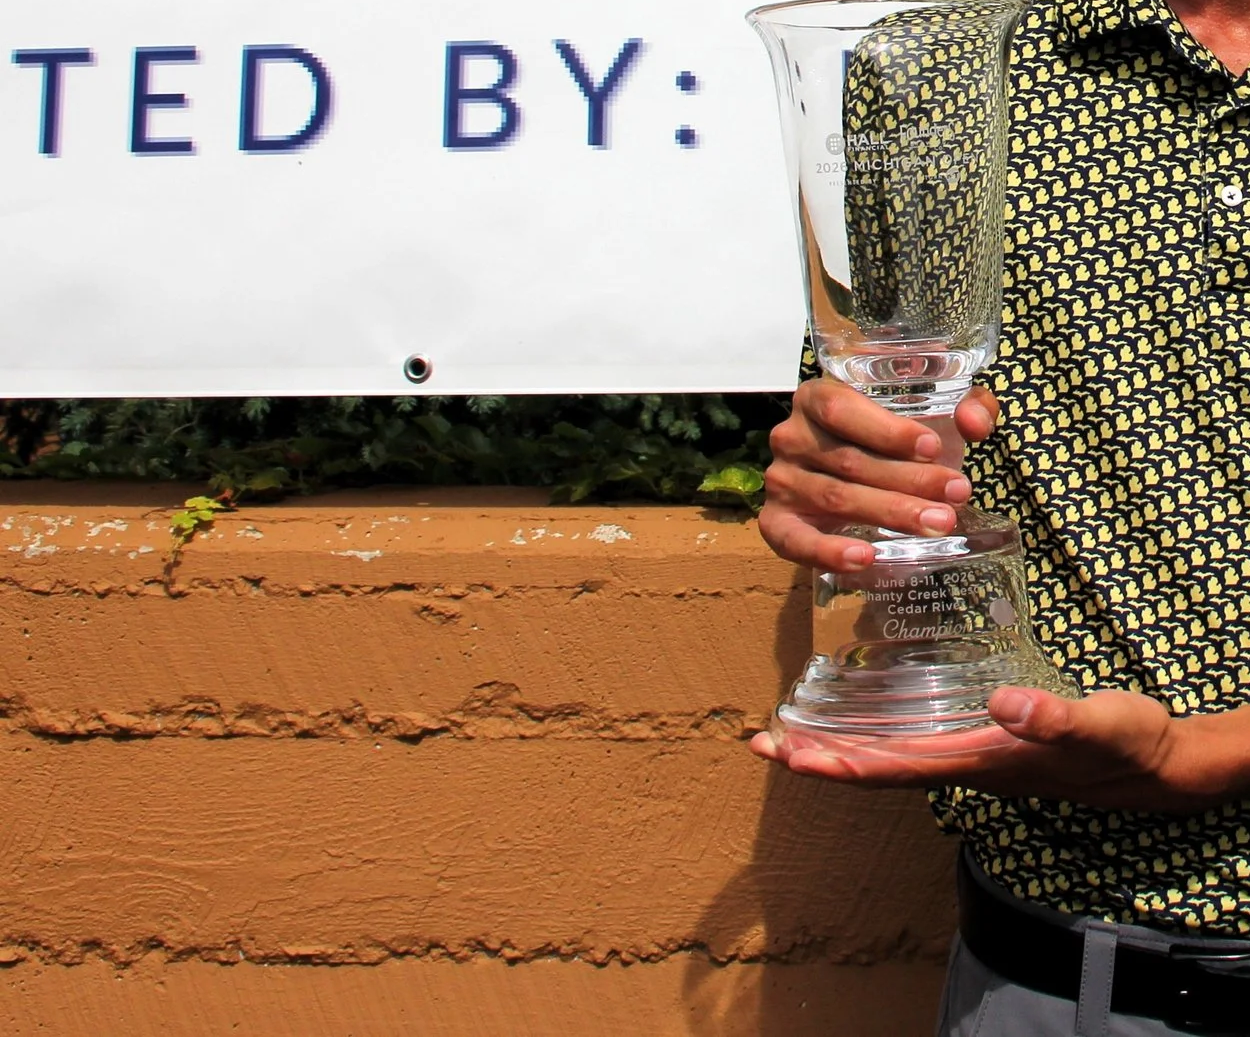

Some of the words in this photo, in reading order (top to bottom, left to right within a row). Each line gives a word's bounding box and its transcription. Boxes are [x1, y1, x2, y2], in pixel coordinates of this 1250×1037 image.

[442, 37, 704, 152] BY:
[846, 132, 892, 147] HALL
[847, 144, 890, 152] FINANCIAL
[816, 162, 848, 174] 2026
[853, 156, 936, 172] MICHIGAN
[874, 577, 905, 588] June
[910, 575, 939, 588] 8-11,
[943, 570, 975, 584] 2026
[908, 588, 947, 600] Creek
[887, 604, 927, 615] Cedar
